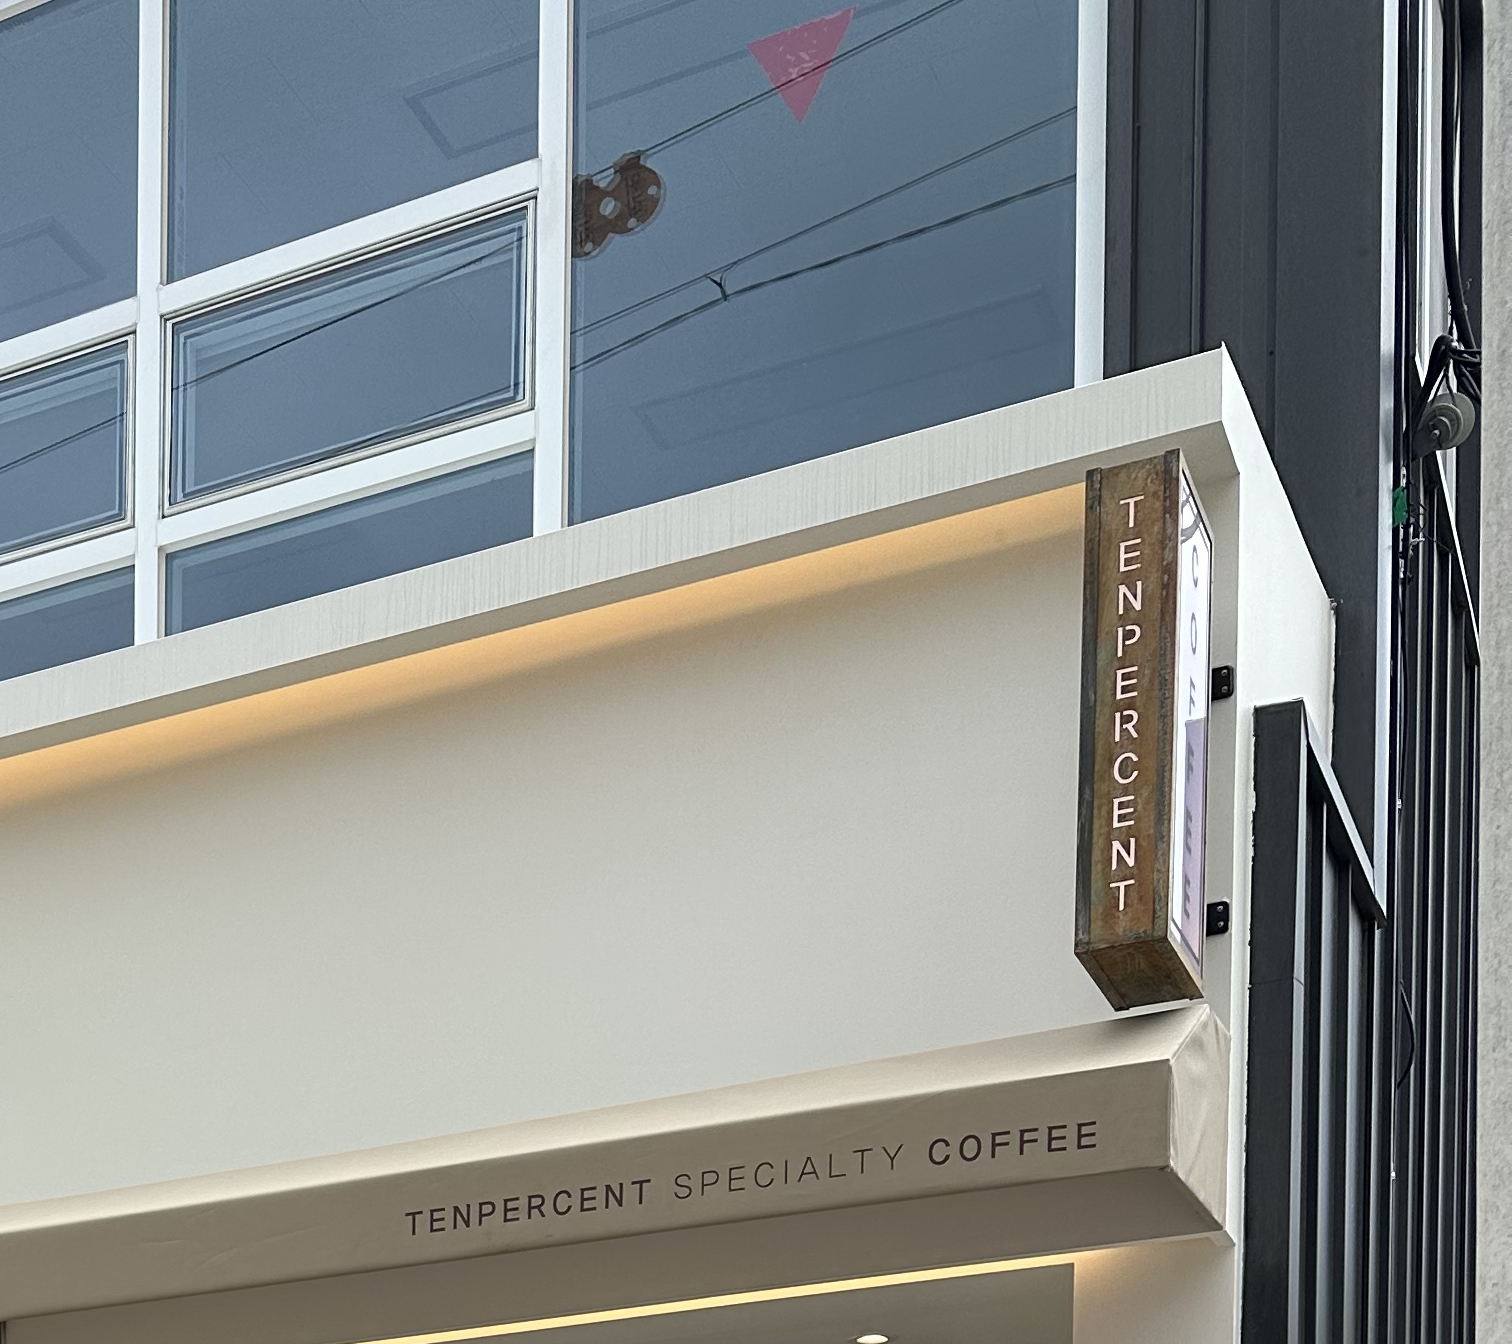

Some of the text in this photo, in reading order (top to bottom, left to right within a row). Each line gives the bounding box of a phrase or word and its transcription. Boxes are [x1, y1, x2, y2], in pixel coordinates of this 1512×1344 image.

[1110, 495, 1145, 913] TENPERCENT
[404, 1121, 1099, 1237] TENPERCENT SPECIALTY COFFEE
